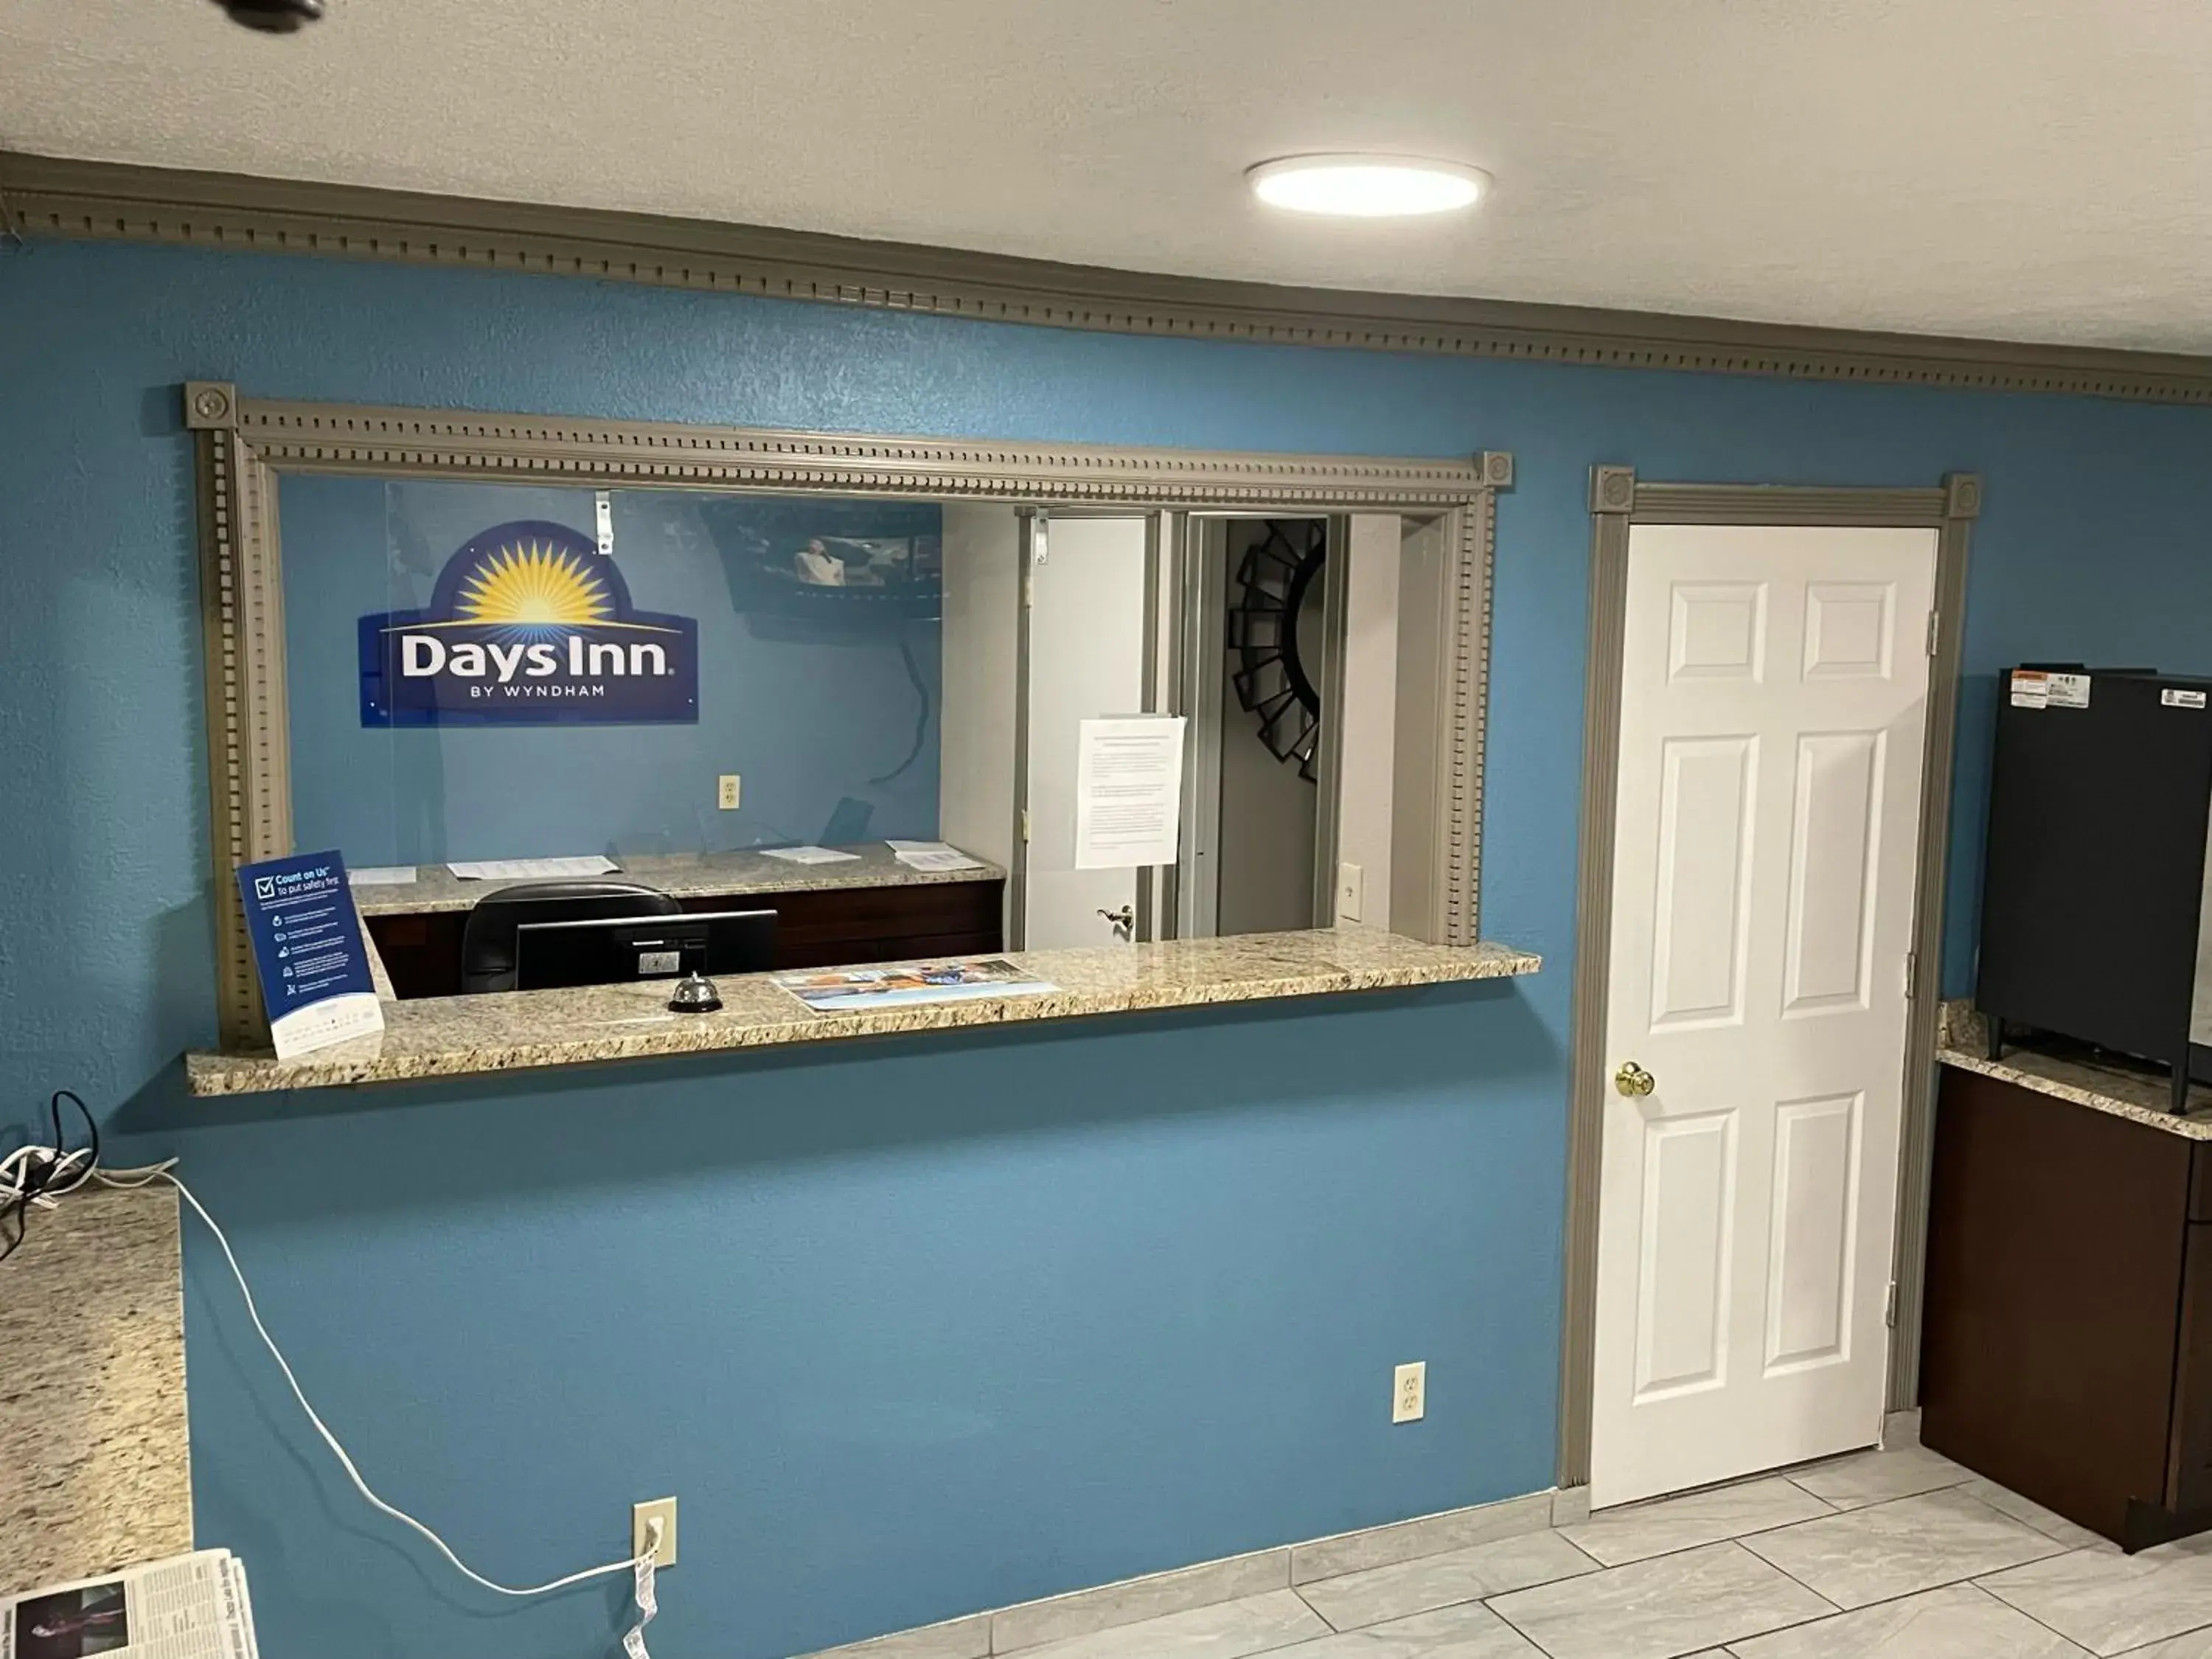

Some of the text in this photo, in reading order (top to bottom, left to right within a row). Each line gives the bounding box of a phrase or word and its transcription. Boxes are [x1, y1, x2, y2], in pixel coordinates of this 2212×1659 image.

[402, 635, 667, 683] Days Inn
[470, 685, 605, 698] BY WYNDHAM
[275, 873, 302, 885] Count
[303, 871, 315, 880] on
